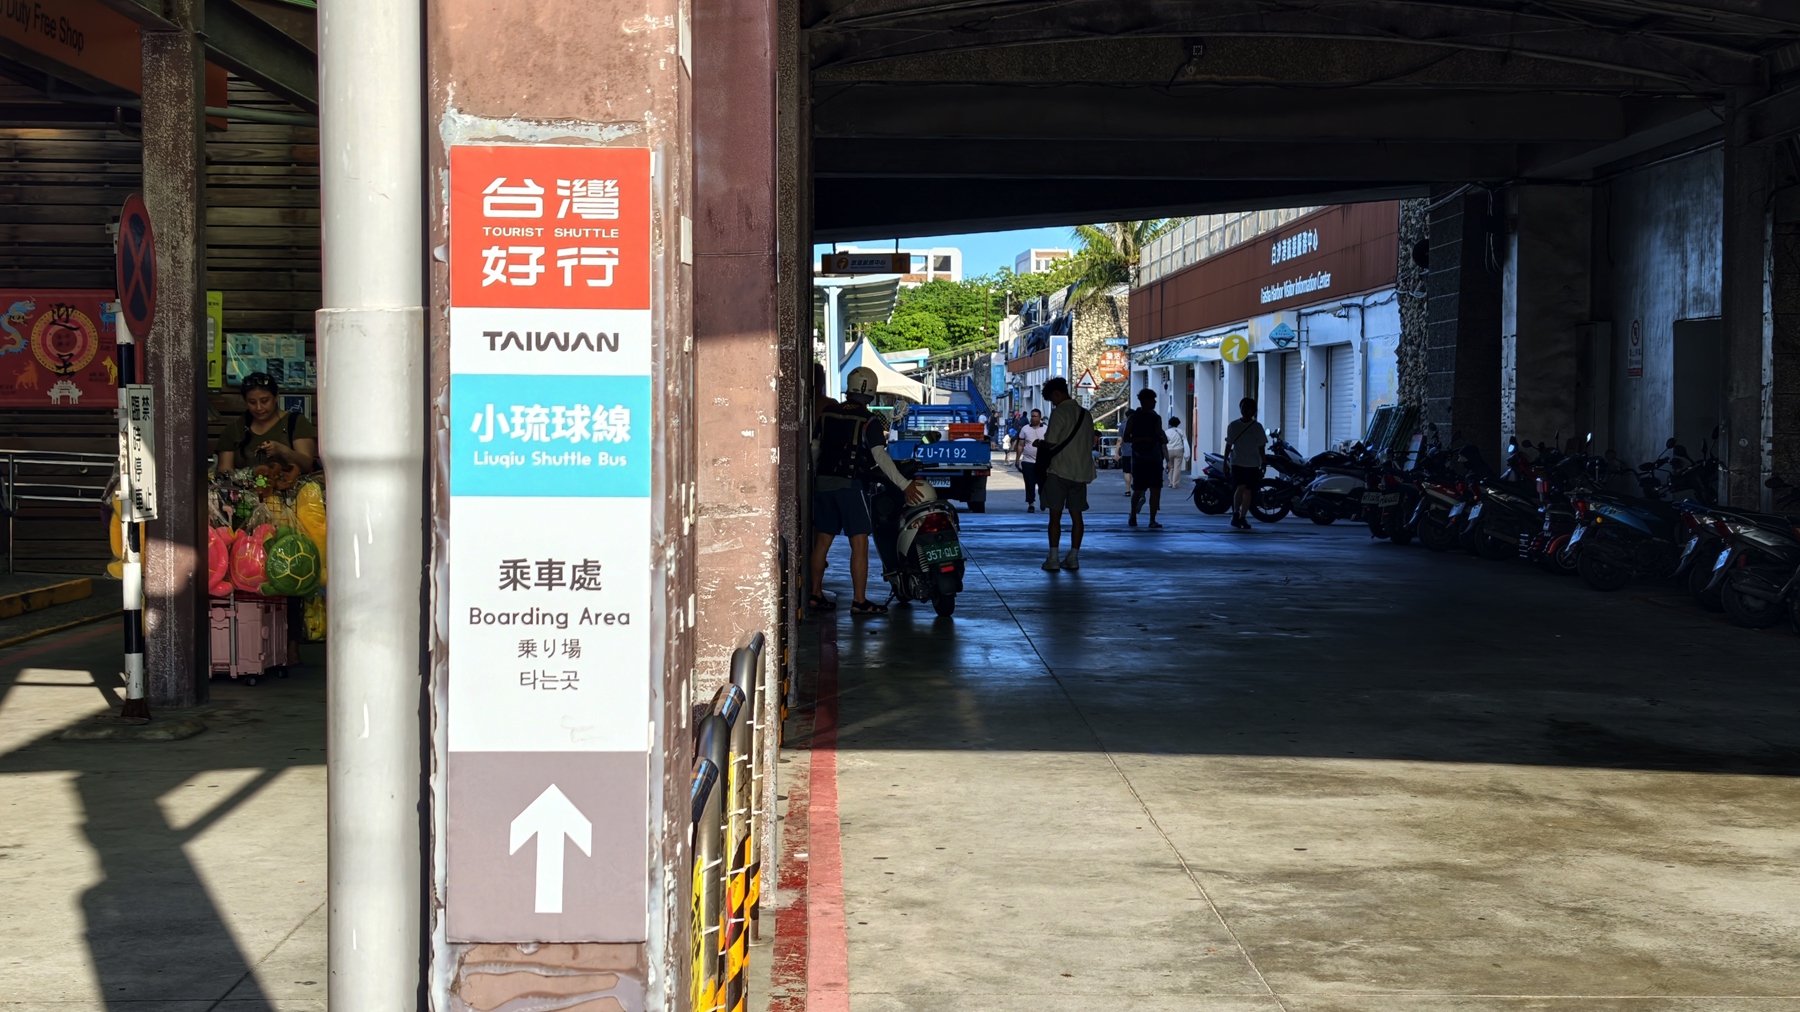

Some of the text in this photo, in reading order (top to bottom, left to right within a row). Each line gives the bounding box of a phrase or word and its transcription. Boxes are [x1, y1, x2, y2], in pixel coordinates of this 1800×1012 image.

[7, 0, 84, 56] Duty Free Shop
[482, 177, 619, 219] 台灣
[482, 226, 619, 238] TOURIST SHUTTLE
[482, 245, 619, 287] 好行
[1295, 273, 1317, 295] Information
[1317, 271, 1331, 290] Center
[482, 331, 619, 353] TAIWAN
[469, 403, 631, 444] 小琉球線
[473, 450, 627, 469] Liuqiu Shuttle Bus
[498, 558, 602, 591] 乘車處
[469, 607, 630, 629] Boarding Area
[517, 638, 582, 659] 乗り場
[520, 669, 580, 690] 타는곳
